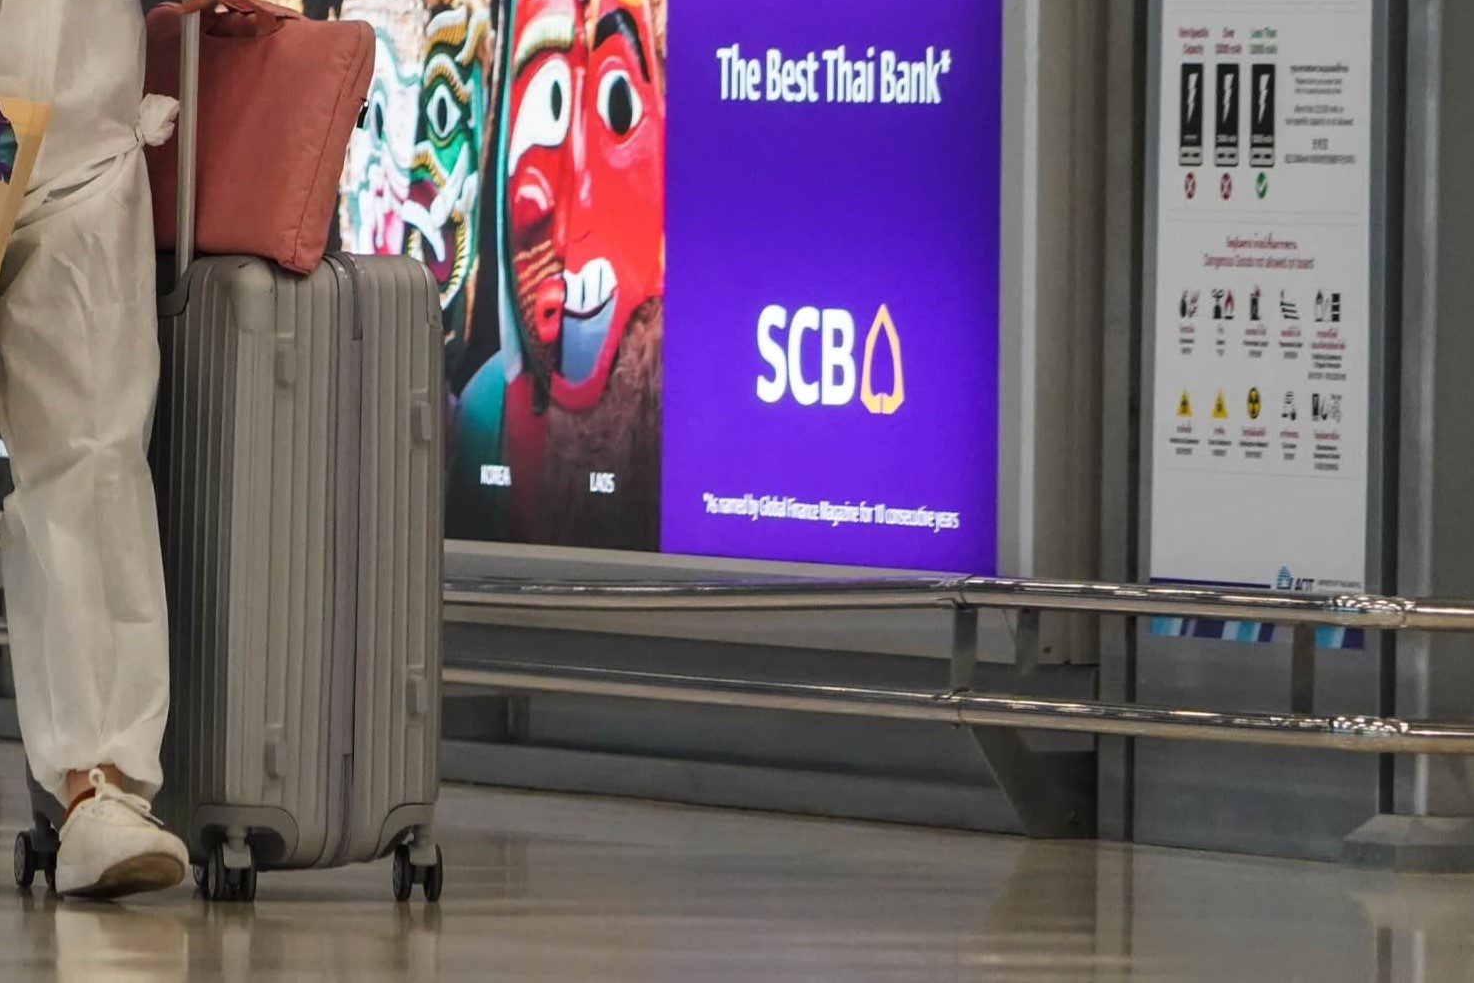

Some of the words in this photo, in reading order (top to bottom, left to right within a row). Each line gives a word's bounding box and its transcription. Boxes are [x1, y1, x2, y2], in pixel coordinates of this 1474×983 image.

[716, 42, 762, 101] The
[765, 46, 821, 104] Best
[823, 45, 875, 104] Thai
[756, 304, 858, 407] SCB
[589, 471, 616, 494] LAOS
[759, 495, 787, 518] Global
[787, 497, 820, 521] Finance
[819, 500, 860, 527] Magazine
[859, 501, 874, 524] for
[885, 505, 936, 528] consecutive
[934, 511, 960, 534] years
